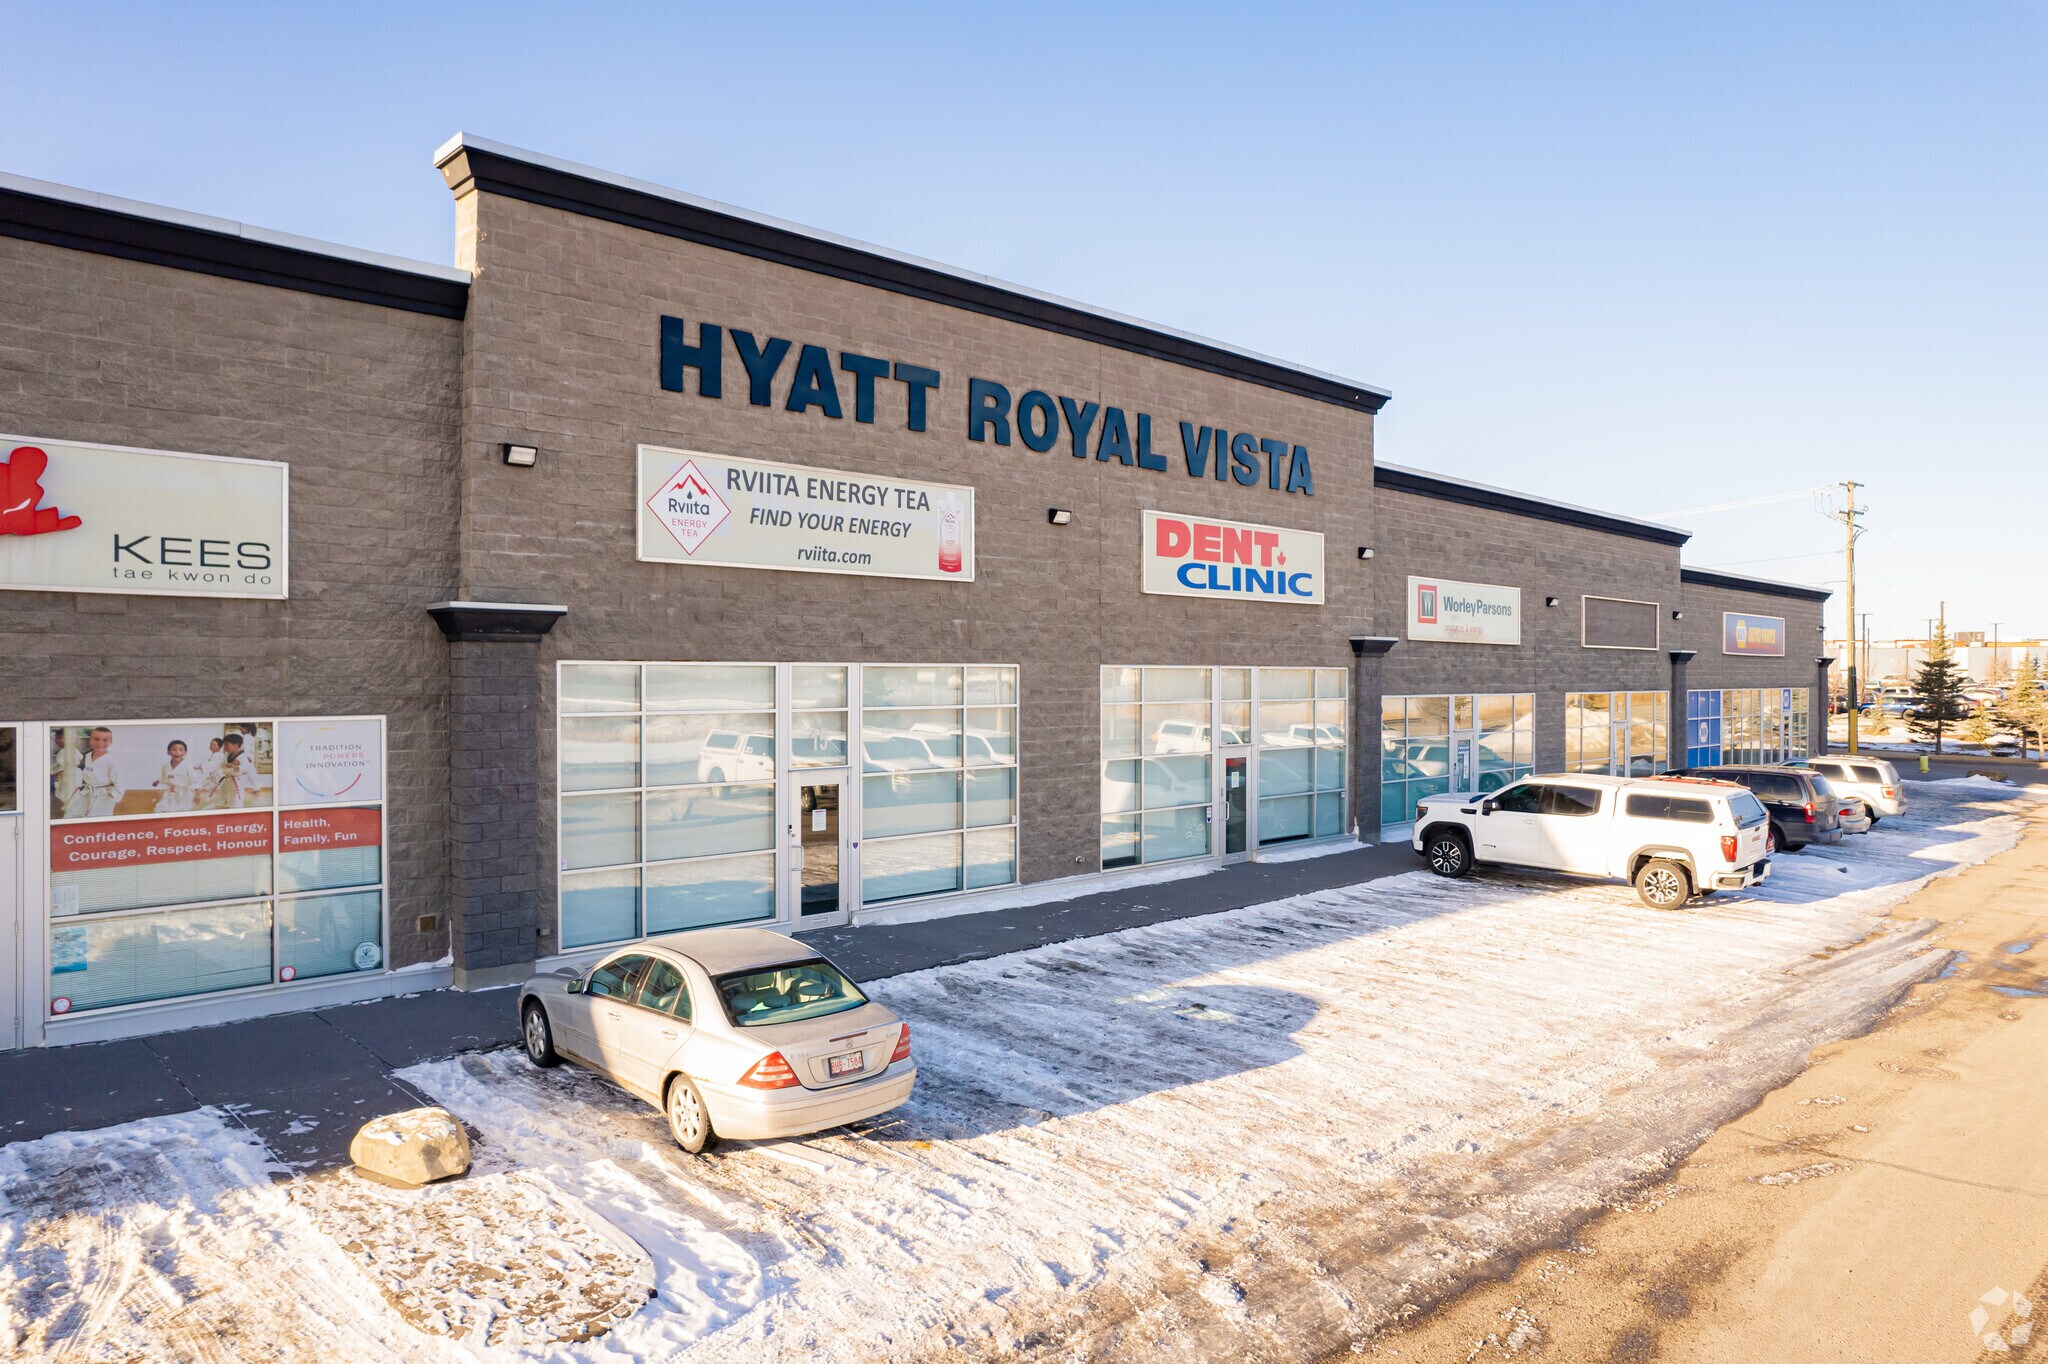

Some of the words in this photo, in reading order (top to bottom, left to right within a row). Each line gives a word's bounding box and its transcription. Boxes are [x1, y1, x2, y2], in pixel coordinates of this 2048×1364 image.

[660, 314, 941, 432] HYATT
[968, 377, 1168, 472] ROYAL
[1179, 421, 1315, 496] VISTA
[726, 468, 800, 497] RVIITA
[806, 477, 889, 505] ENERGY
[894, 488, 931, 512] TEA
[668, 498, 710, 516] Rviita
[671, 517, 708, 528] ENERGY
[681, 528, 699, 537] TEA
[750, 507, 793, 527] FIND
[797, 512, 844, 533] YOUR
[848, 517, 912, 538] ENERGY
[113, 533, 272, 571] KEES
[1156, 518, 1280, 568] DENT
[797, 546, 872, 565] rviita.com
[112, 566, 154, 580] tae
[168, 569, 231, 583] kwon
[244, 573, 272, 585] do
[1176, 562, 1313, 597] CLINIC
[1443, 596, 1512, 617] WorleyParsons
[308, 743, 363, 752] TRADITION
[323, 752, 365, 760] POWERS
[283, 817, 331, 830] Health,
[63, 829, 159, 846] Confidence,
[163, 826, 212, 838] Focus,
[216, 822, 268, 835] Energy,
[283, 832, 332, 845] Family,
[334, 830, 358, 842] Fun
[68, 848, 142, 863] Courage,
[146, 842, 212, 858] Respect,
[216, 837, 268, 850] Honour
